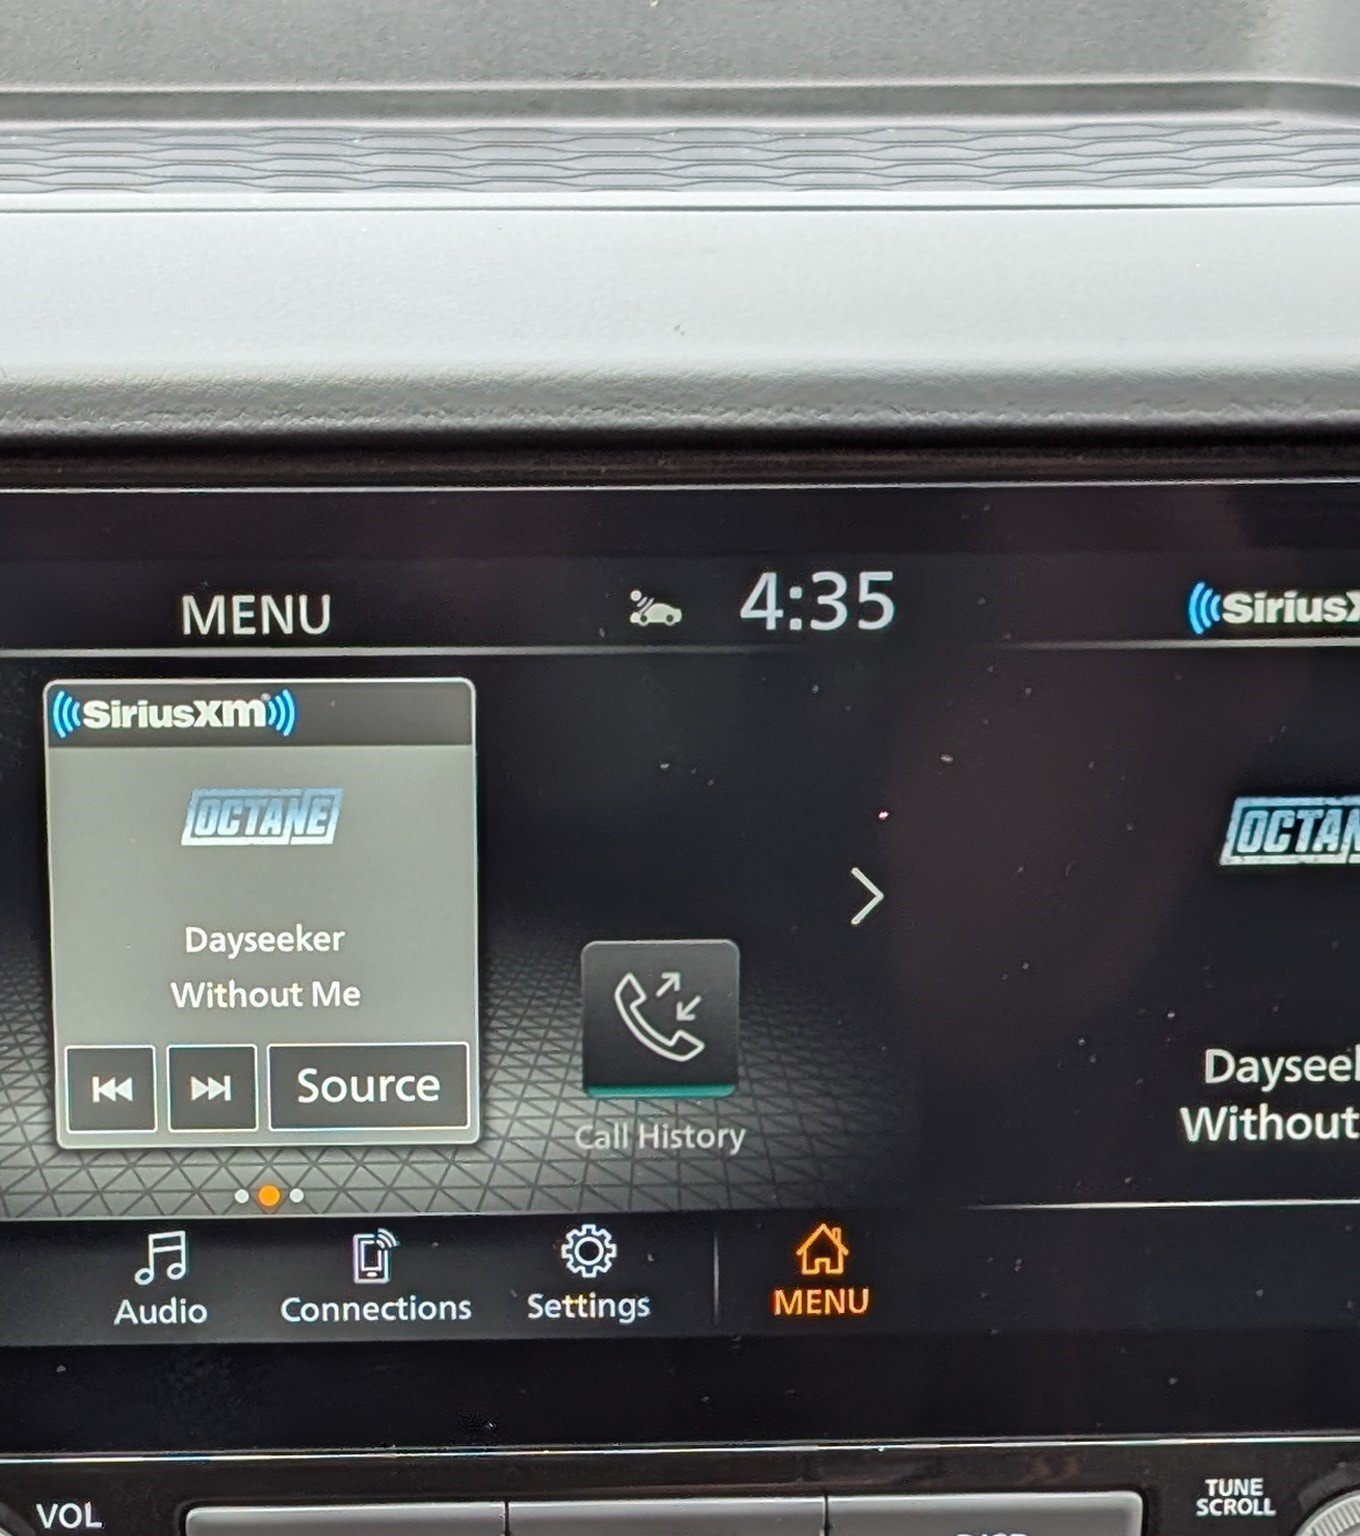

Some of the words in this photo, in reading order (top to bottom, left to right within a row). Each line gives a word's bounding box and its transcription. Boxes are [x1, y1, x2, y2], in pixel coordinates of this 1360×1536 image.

[181, 595, 332, 635] MENU
[739, 572, 894, 632] 4:35
[194, 797, 332, 836] OCTANE
[185, 926, 346, 957] Dayseeker
[171, 982, 304, 1010] Without
[312, 982, 361, 1010] Me
[296, 1068, 441, 1104] Source
[575, 1124, 632, 1151] Call
[640, 1122, 747, 1157] History
[1181, 1106, 1360, 1144] Without
[114, 1297, 209, 1326] Audio
[280, 1293, 473, 1323] Connections
[527, 1291, 651, 1325] Settings
[773, 1287, 870, 1317] MENU
[1206, 1478, 1264, 1501] TUNE
[36, 1503, 103, 1531] VOL
[1195, 1493, 1277, 1518] SCROLL
